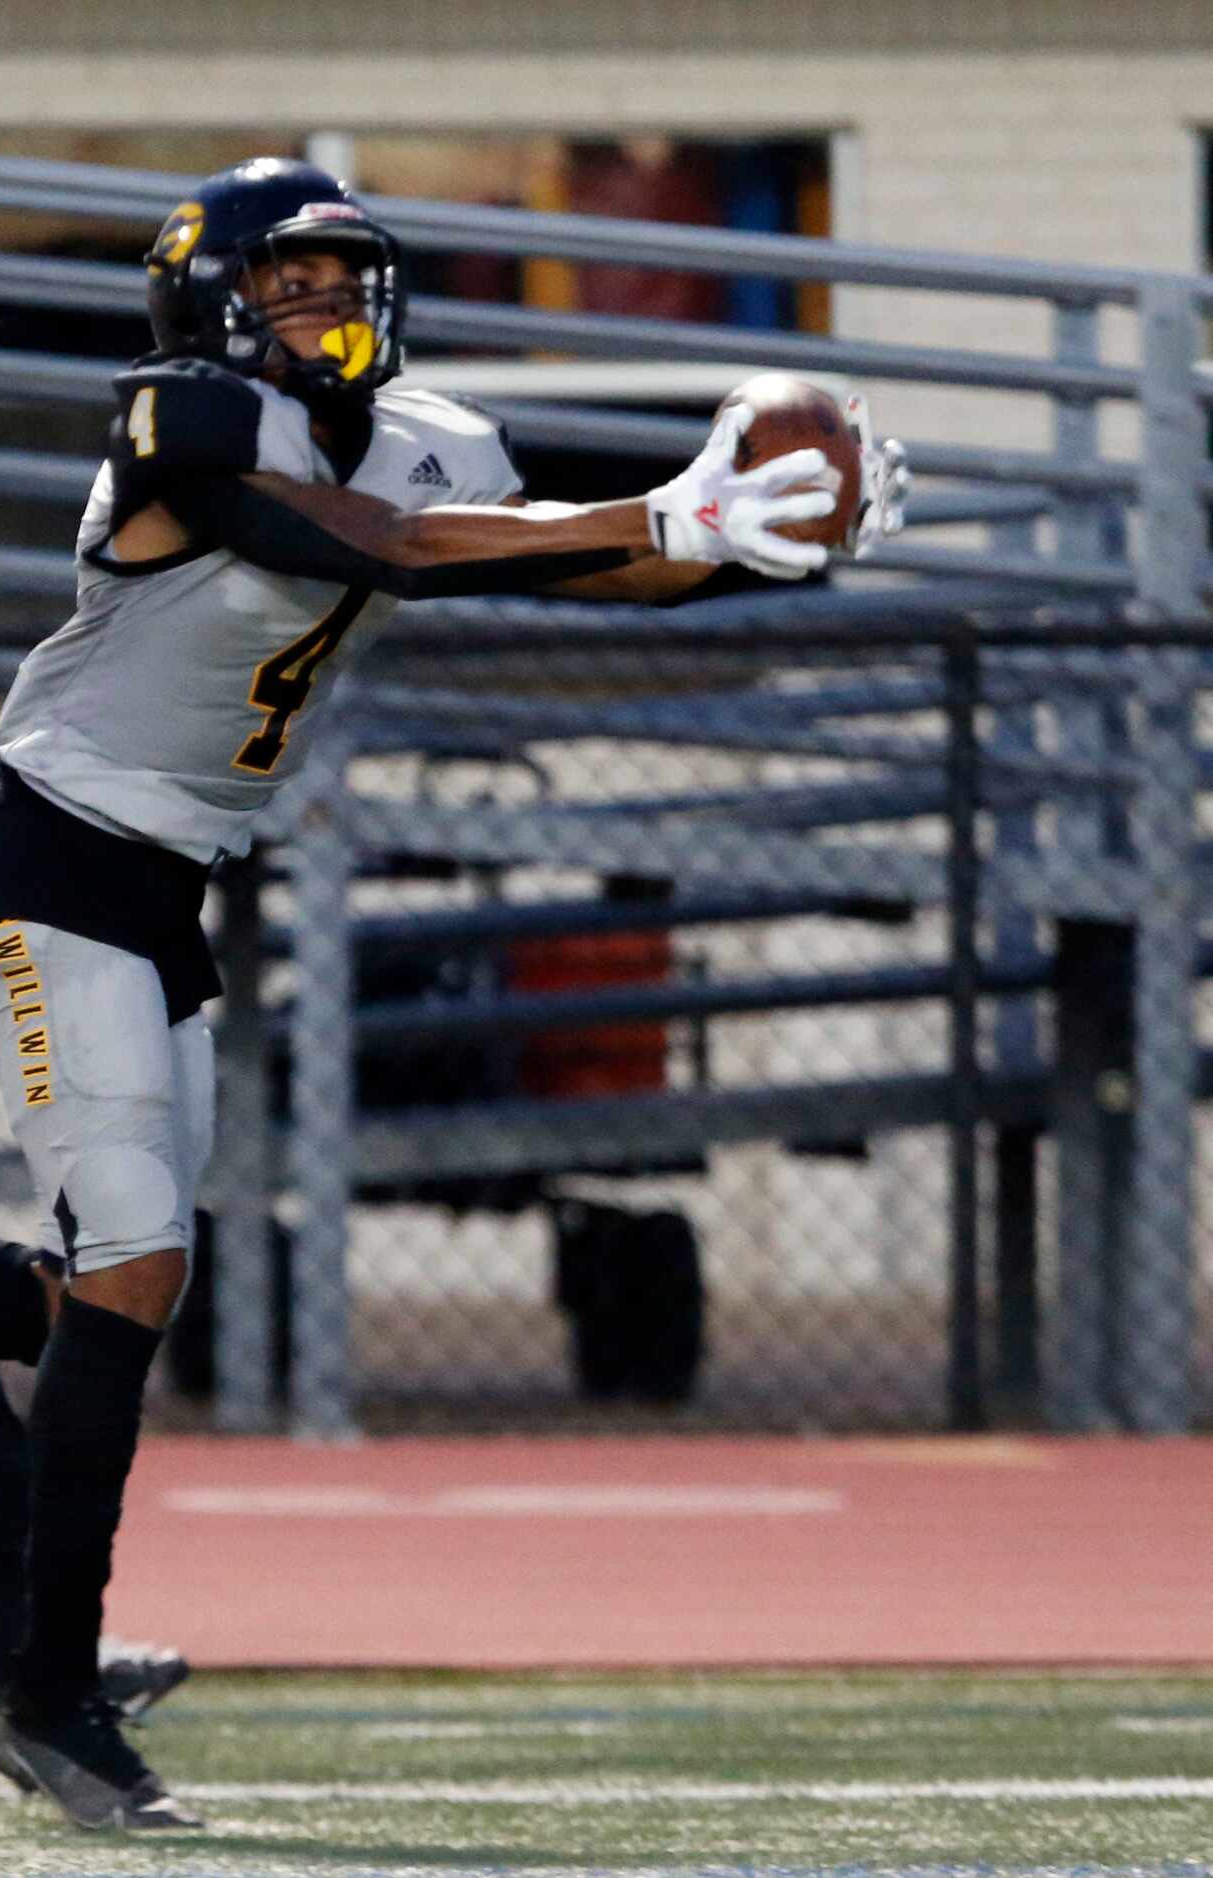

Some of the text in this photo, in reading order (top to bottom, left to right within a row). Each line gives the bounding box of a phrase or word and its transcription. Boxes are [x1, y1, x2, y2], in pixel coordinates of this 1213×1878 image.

[128, 387, 157, 457] 4
[231, 583, 373, 775] 4
[18, 1029, 55, 1106] WIN
